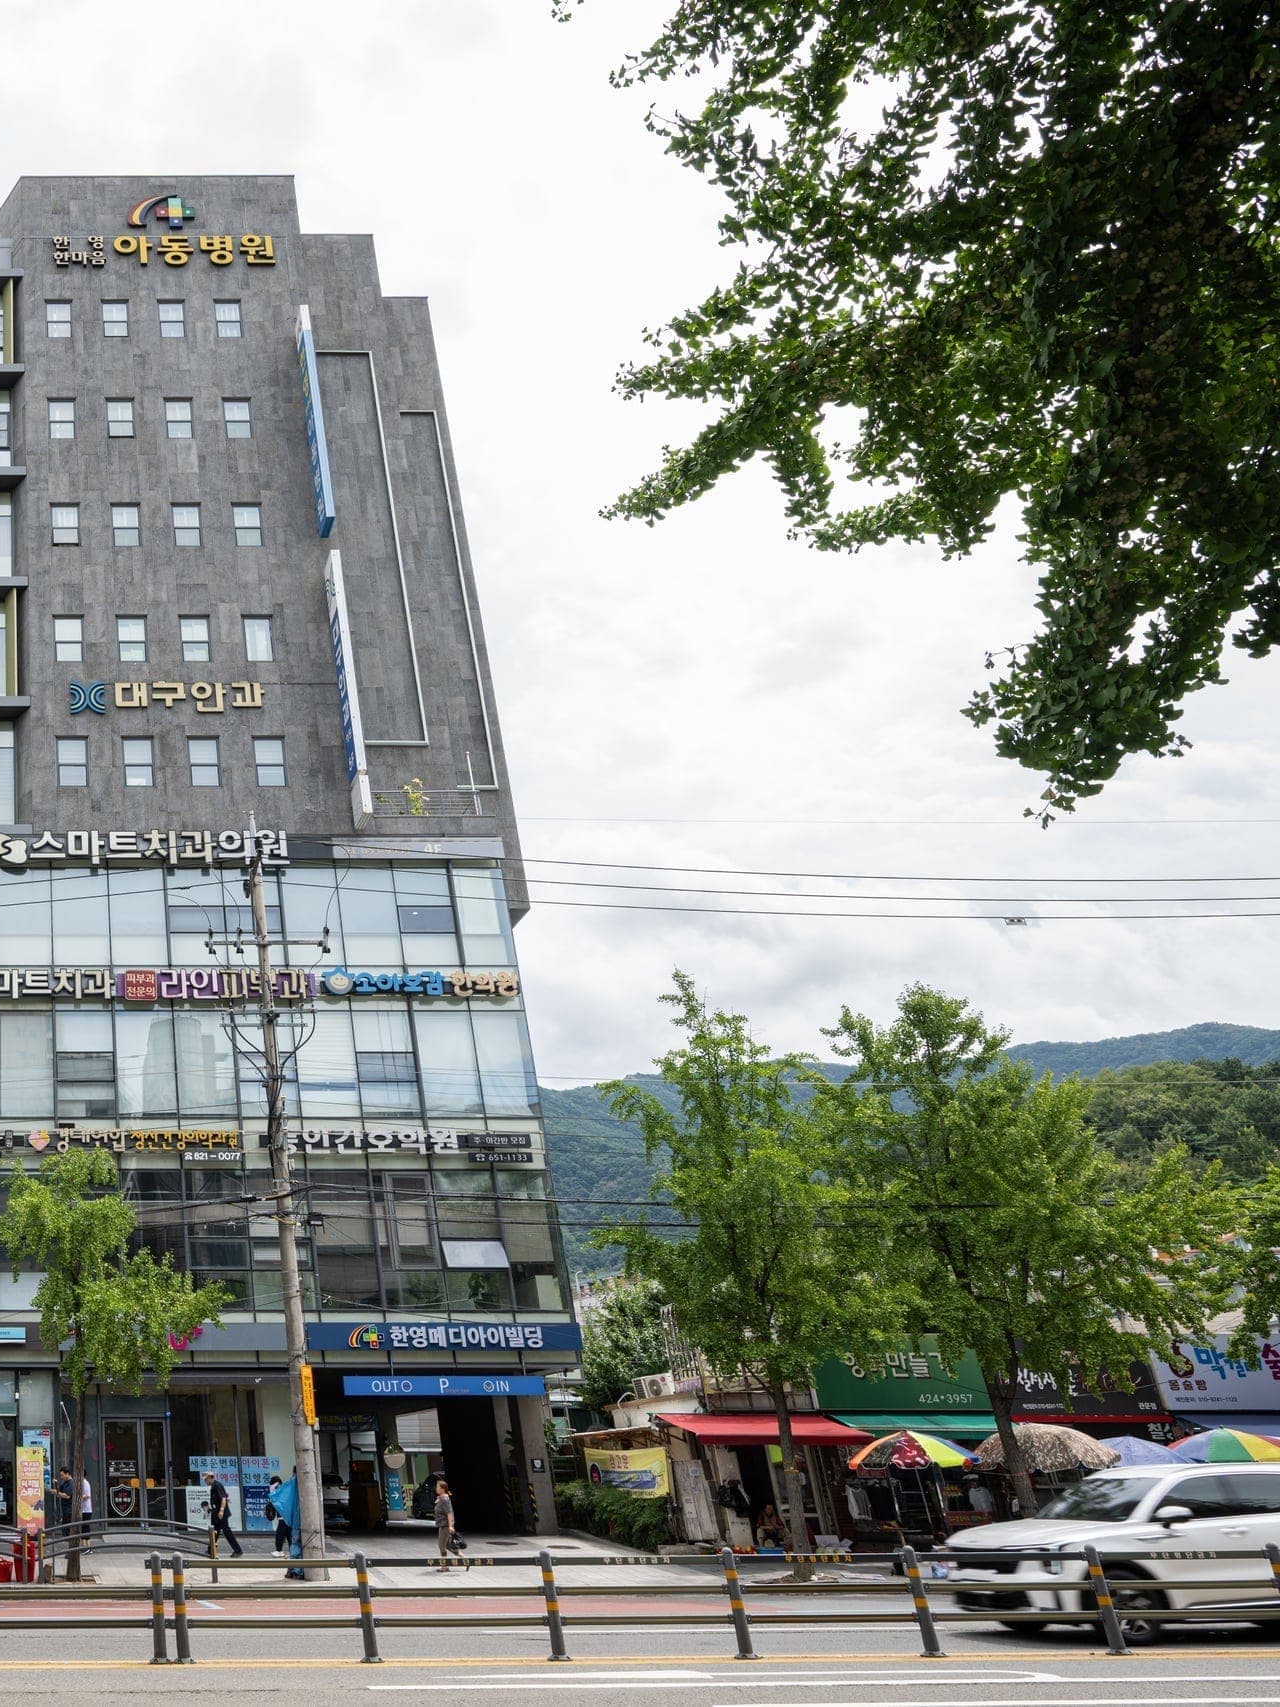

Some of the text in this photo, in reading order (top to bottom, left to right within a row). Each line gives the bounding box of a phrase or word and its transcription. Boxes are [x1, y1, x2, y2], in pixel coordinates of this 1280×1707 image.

[53, 250, 107, 266] 한마음
[113, 234, 277, 266] 아동병원
[114, 681, 266, 713] 대구안과
[29, 829, 291, 865] 스마트치과의원
[126, 973, 156, 984] 피부과
[125, 985, 156, 998] 전문의
[389, 1326, 544, 1349] 한영메디아이빌딩
[371, 1378, 510, 1394] OUT P IN
